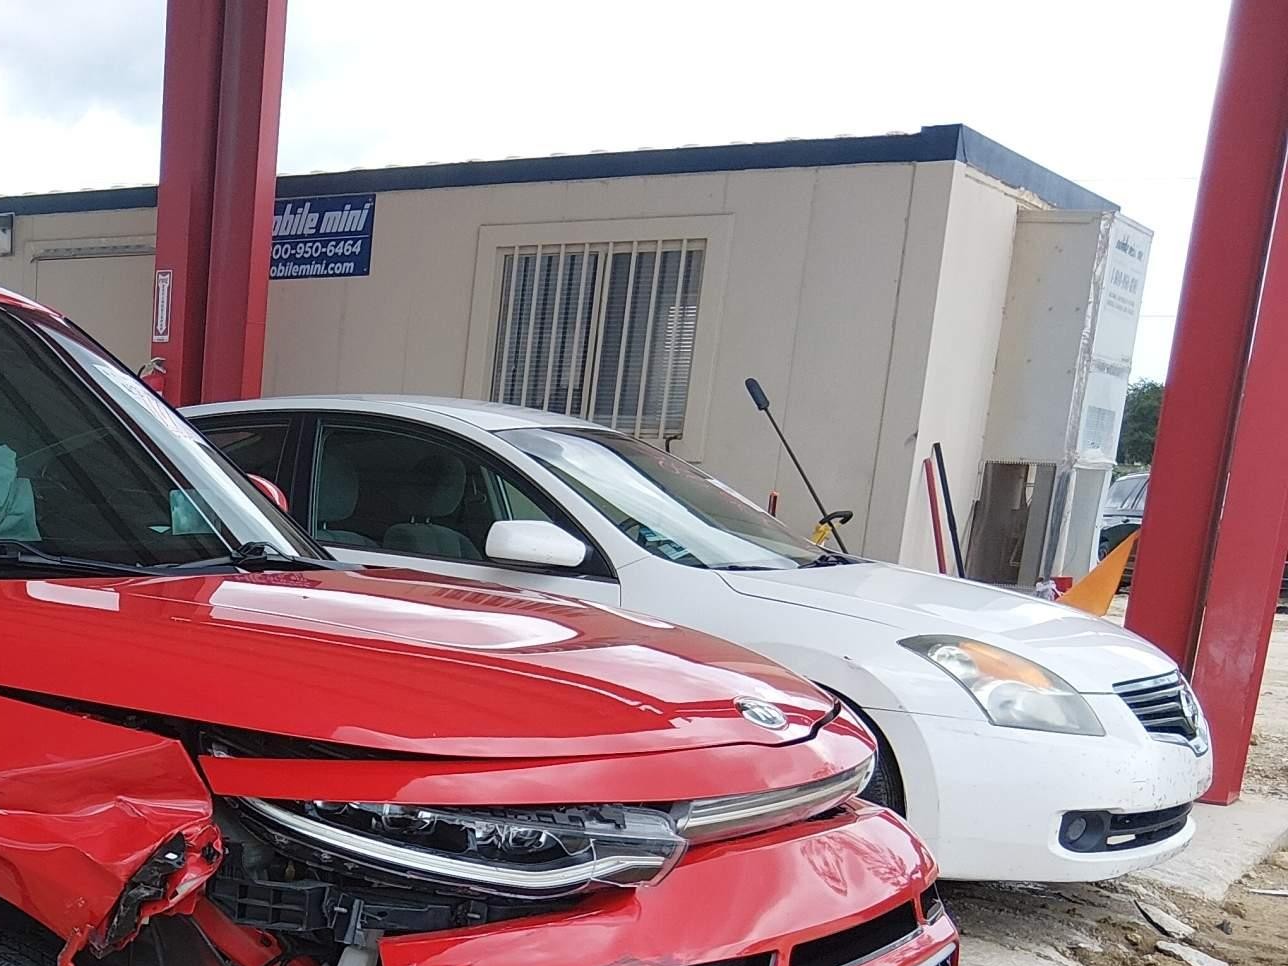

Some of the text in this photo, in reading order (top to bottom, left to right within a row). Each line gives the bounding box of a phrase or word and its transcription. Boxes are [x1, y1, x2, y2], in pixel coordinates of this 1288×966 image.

[272, 202, 370, 236] obile mini
[272, 240, 361, 259] 00-950-6464
[270, 260, 354, 277] obilemini.com
